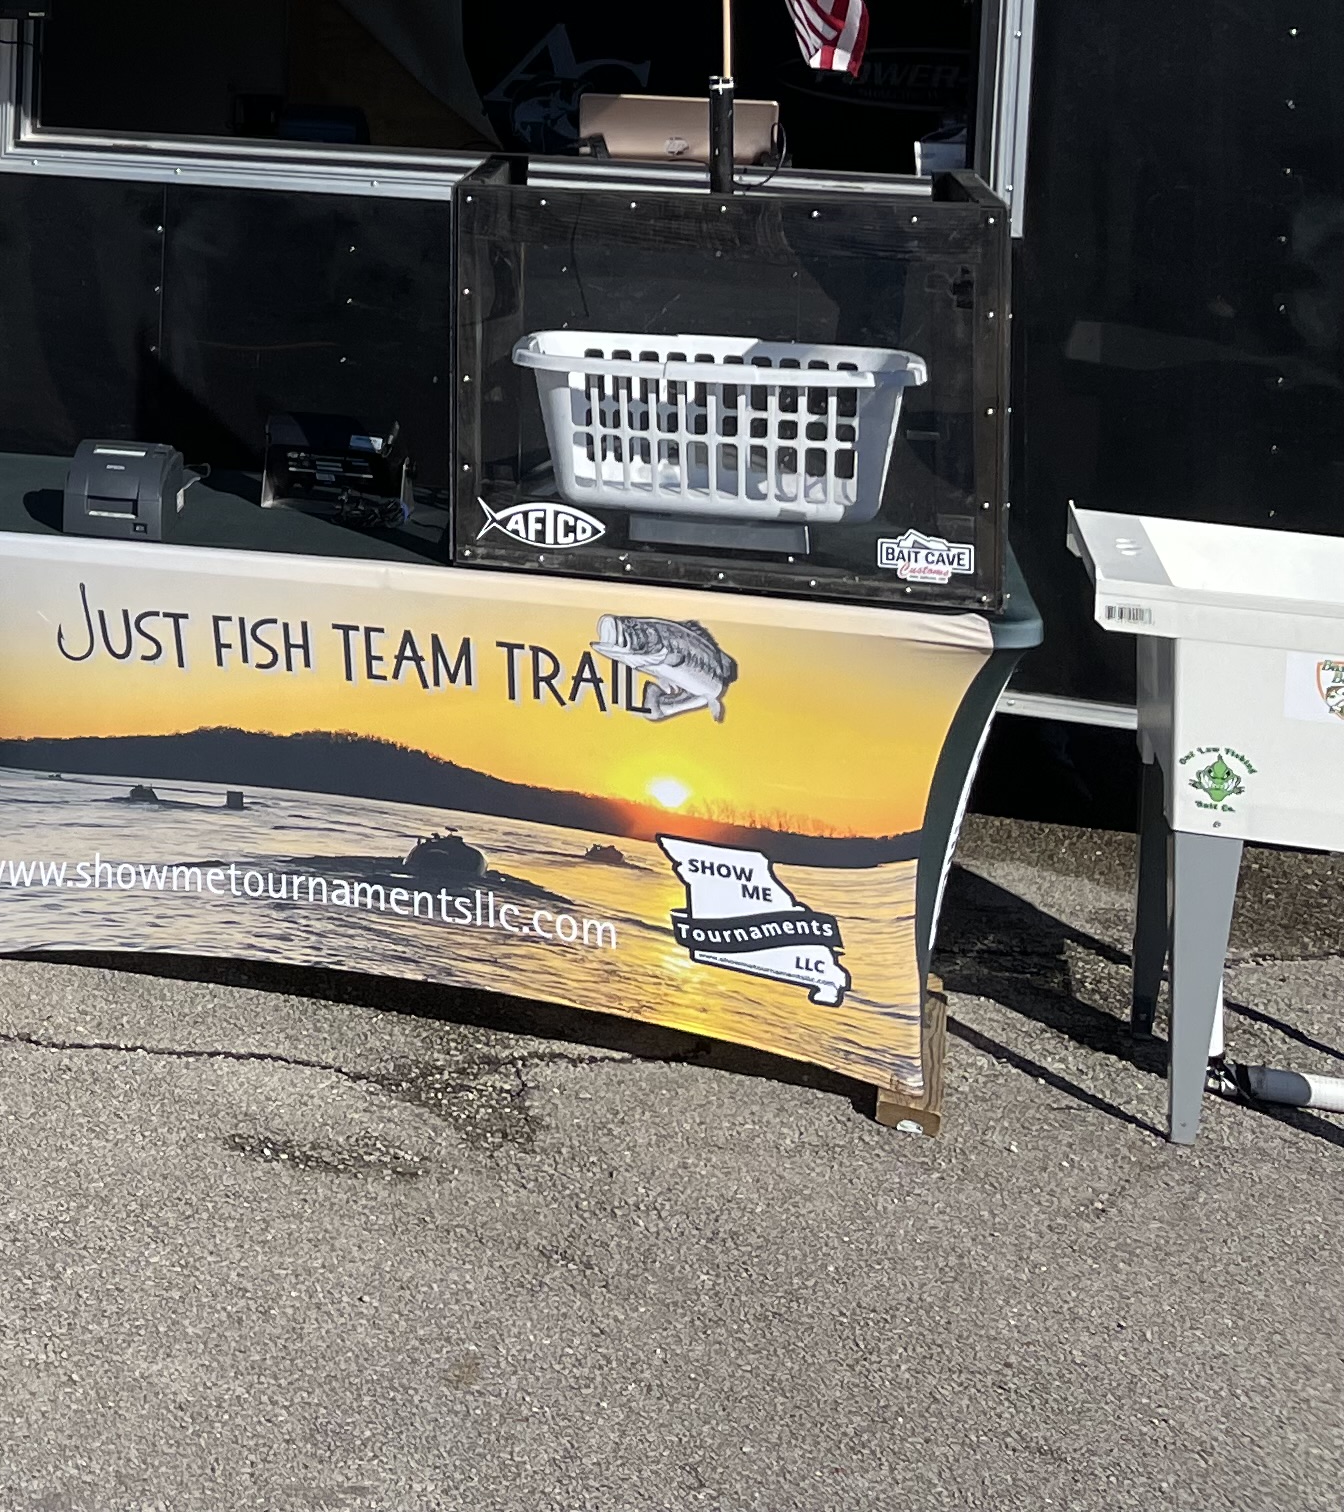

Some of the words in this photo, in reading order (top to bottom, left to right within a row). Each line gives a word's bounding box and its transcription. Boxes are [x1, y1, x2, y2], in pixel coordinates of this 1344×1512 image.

[506, 508, 592, 544] AFTCO
[886, 547, 921, 563] BAIT
[925, 551, 966, 567] CAVE
[899, 561, 949, 579] Customs
[57, 583, 188, 669] JUST
[212, 615, 312, 672] FISH
[332, 623, 472, 690] TEAM
[496, 641, 652, 714] TRAIL
[688, 859, 754, 882] SHOW
[741, 884, 773, 902] ME
[677, 919, 833, 943] Tournaments
[795, 956, 826, 974] LLC
